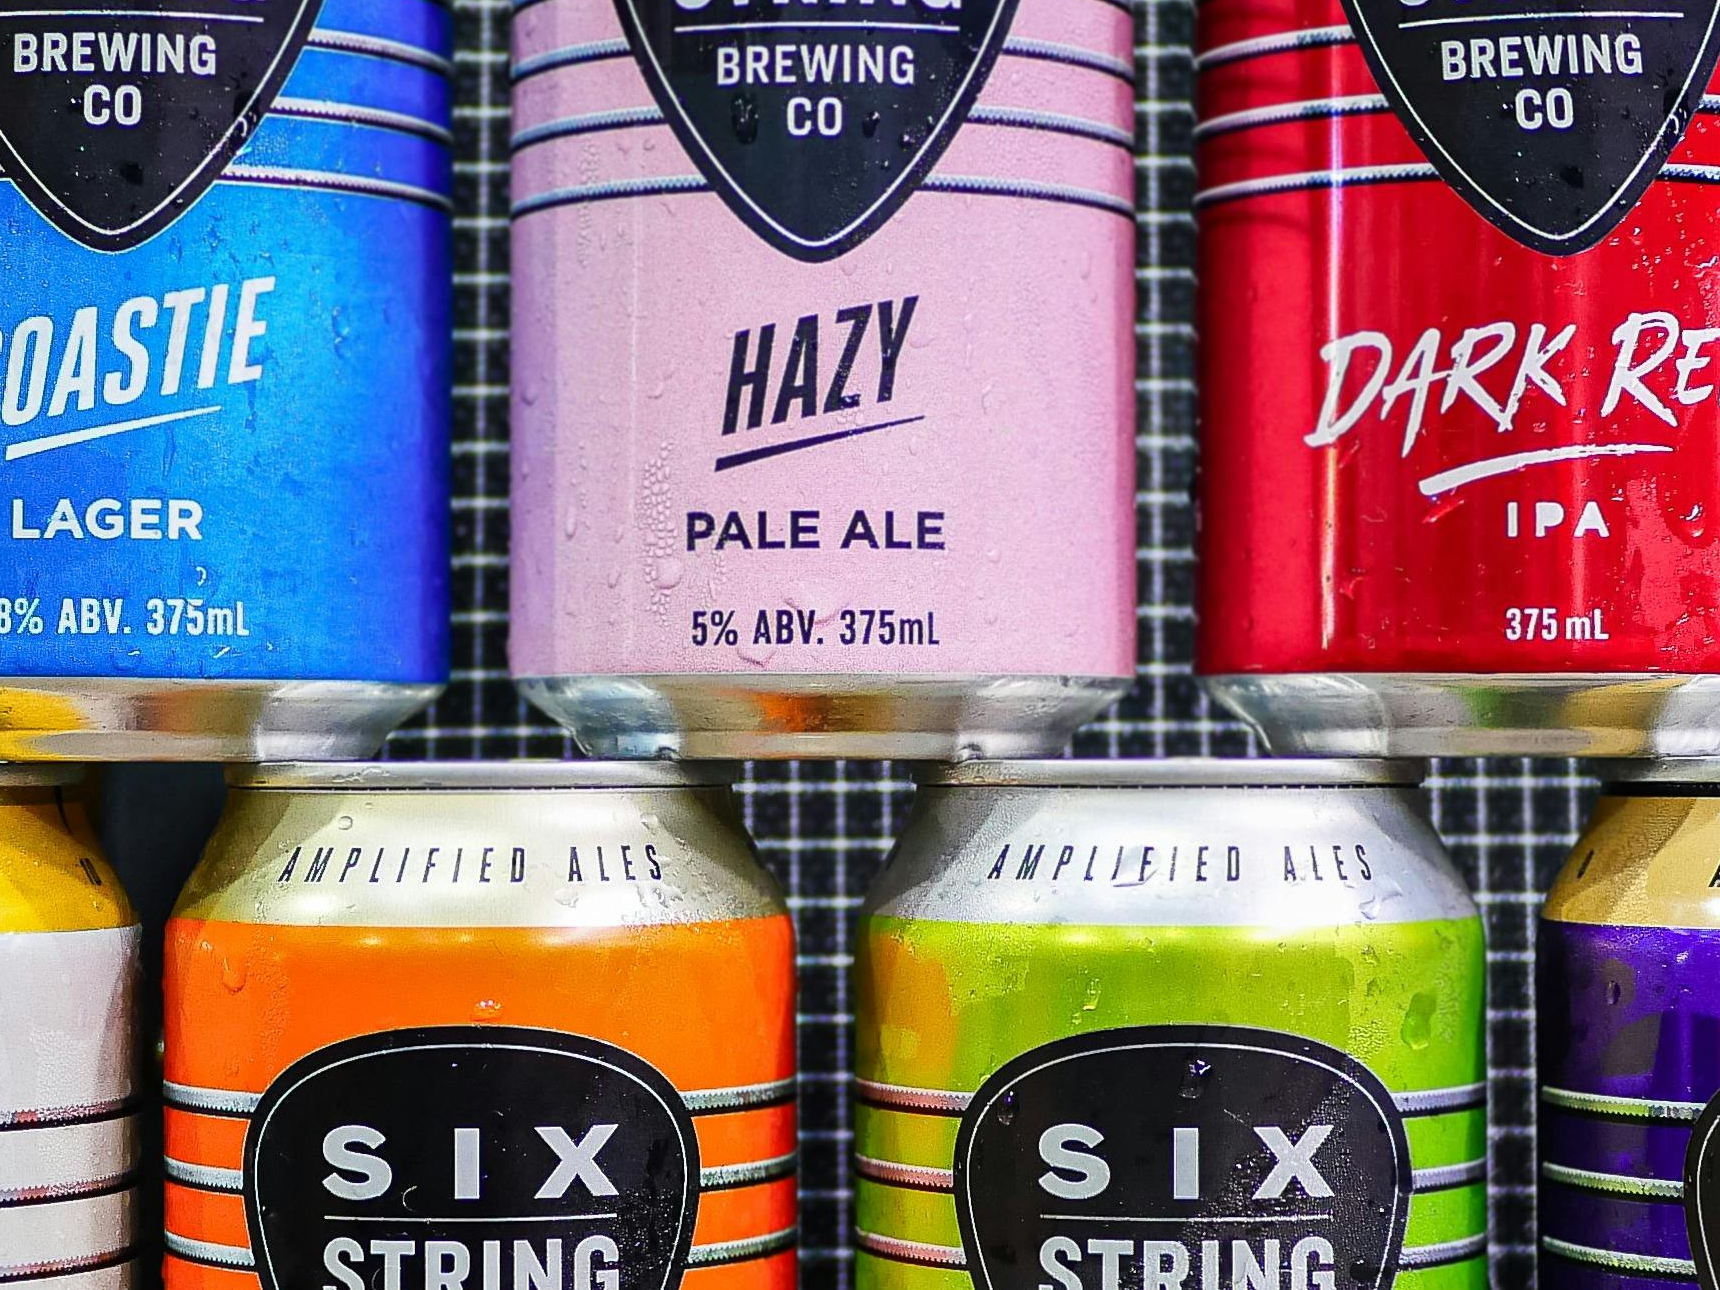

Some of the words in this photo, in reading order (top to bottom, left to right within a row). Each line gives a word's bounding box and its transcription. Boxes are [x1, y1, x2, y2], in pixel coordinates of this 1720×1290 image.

[13, 32, 217, 74] BREWING
[717, 45, 915, 86] BREWING
[1441, 33, 1643, 81] BREWING
[84, 85, 142, 126] CO
[786, 97, 843, 137] CO
[1514, 89, 1574, 130] CO
[720, 295, 920, 436] HAZY
[1304, 321, 1576, 459] DARK
[11, 498, 203, 541] LAGER
[685, 511, 820, 552] PALE
[840, 511, 946, 552] ALE
[1506, 501, 1609, 538] IPA
[58, 599, 132, 635] ABV.
[146, 598, 250, 637] 375mL
[692, 610, 738, 647] 5%
[752, 610, 825, 647] ABV.
[839, 610, 940, 647] 375mL
[278, 847, 525, 885] AMPLIFIED
[567, 846, 663, 881] ALES
[987, 844, 1241, 888] AMPLIFIED
[1283, 845, 1371, 882] ALES
[322, 1123, 618, 1201] SIX
[1038, 1123, 1335, 1200] SIX
